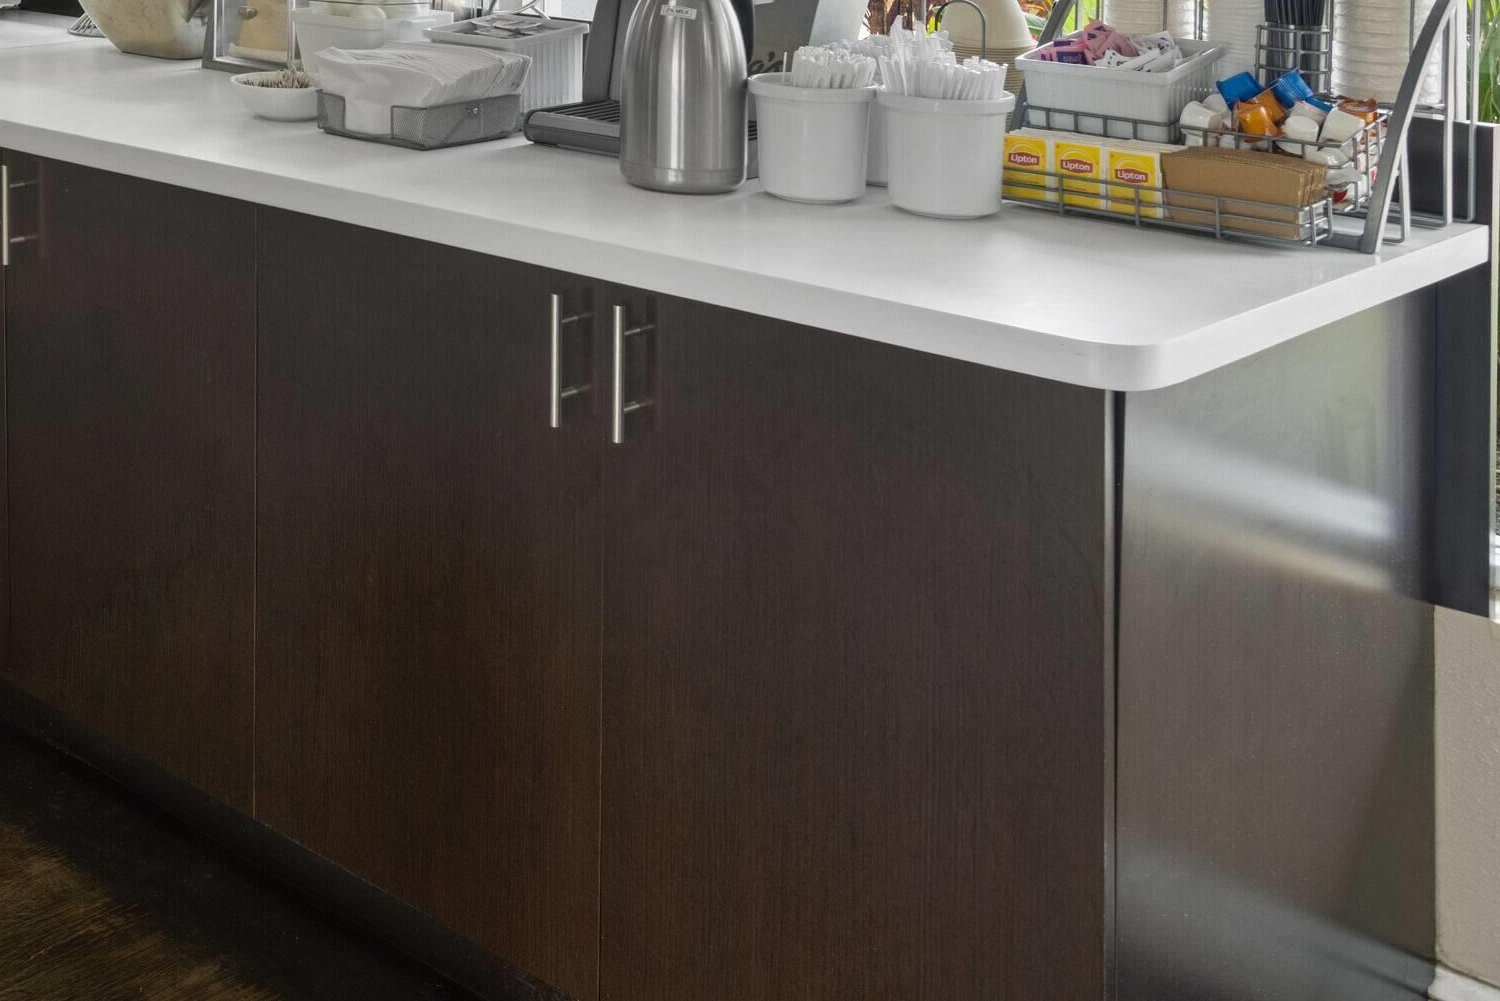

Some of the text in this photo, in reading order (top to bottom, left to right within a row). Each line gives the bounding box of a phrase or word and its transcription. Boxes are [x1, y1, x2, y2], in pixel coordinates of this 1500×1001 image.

[1010, 153, 1038, 164] Lipton
[1062, 161, 1091, 172] Lipton
[1117, 170, 1146, 181] Lipton
